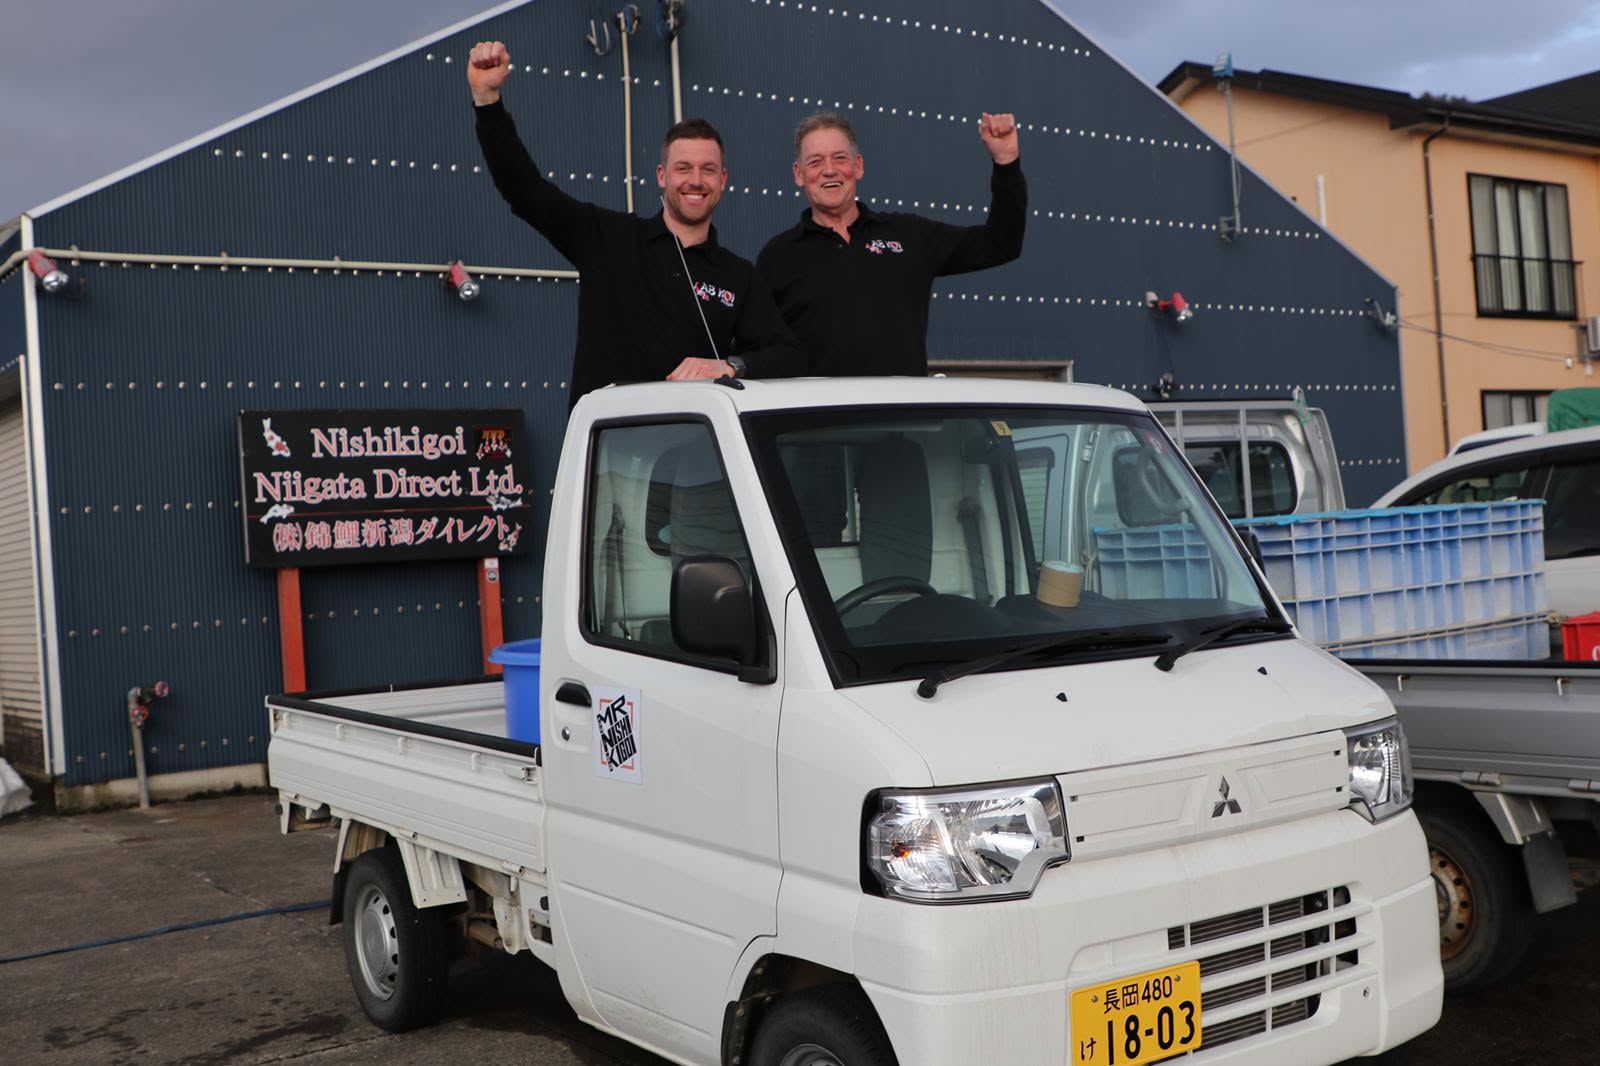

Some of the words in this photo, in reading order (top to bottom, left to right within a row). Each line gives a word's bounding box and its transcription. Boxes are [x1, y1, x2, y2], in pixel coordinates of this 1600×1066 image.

[310, 426, 467, 460] Nishikigoi
[253, 470, 367, 504] Niigata
[373, 467, 463, 499] Direct
[468, 464, 524, 497] Ltd.
[597, 694, 628, 734] MR
[601, 714, 632, 753] NISHI
[606, 733, 637, 772] KIGOI
[1080, 1037, 1097, 1061] け
[1107, 1000, 1195, 1066] 18-03
